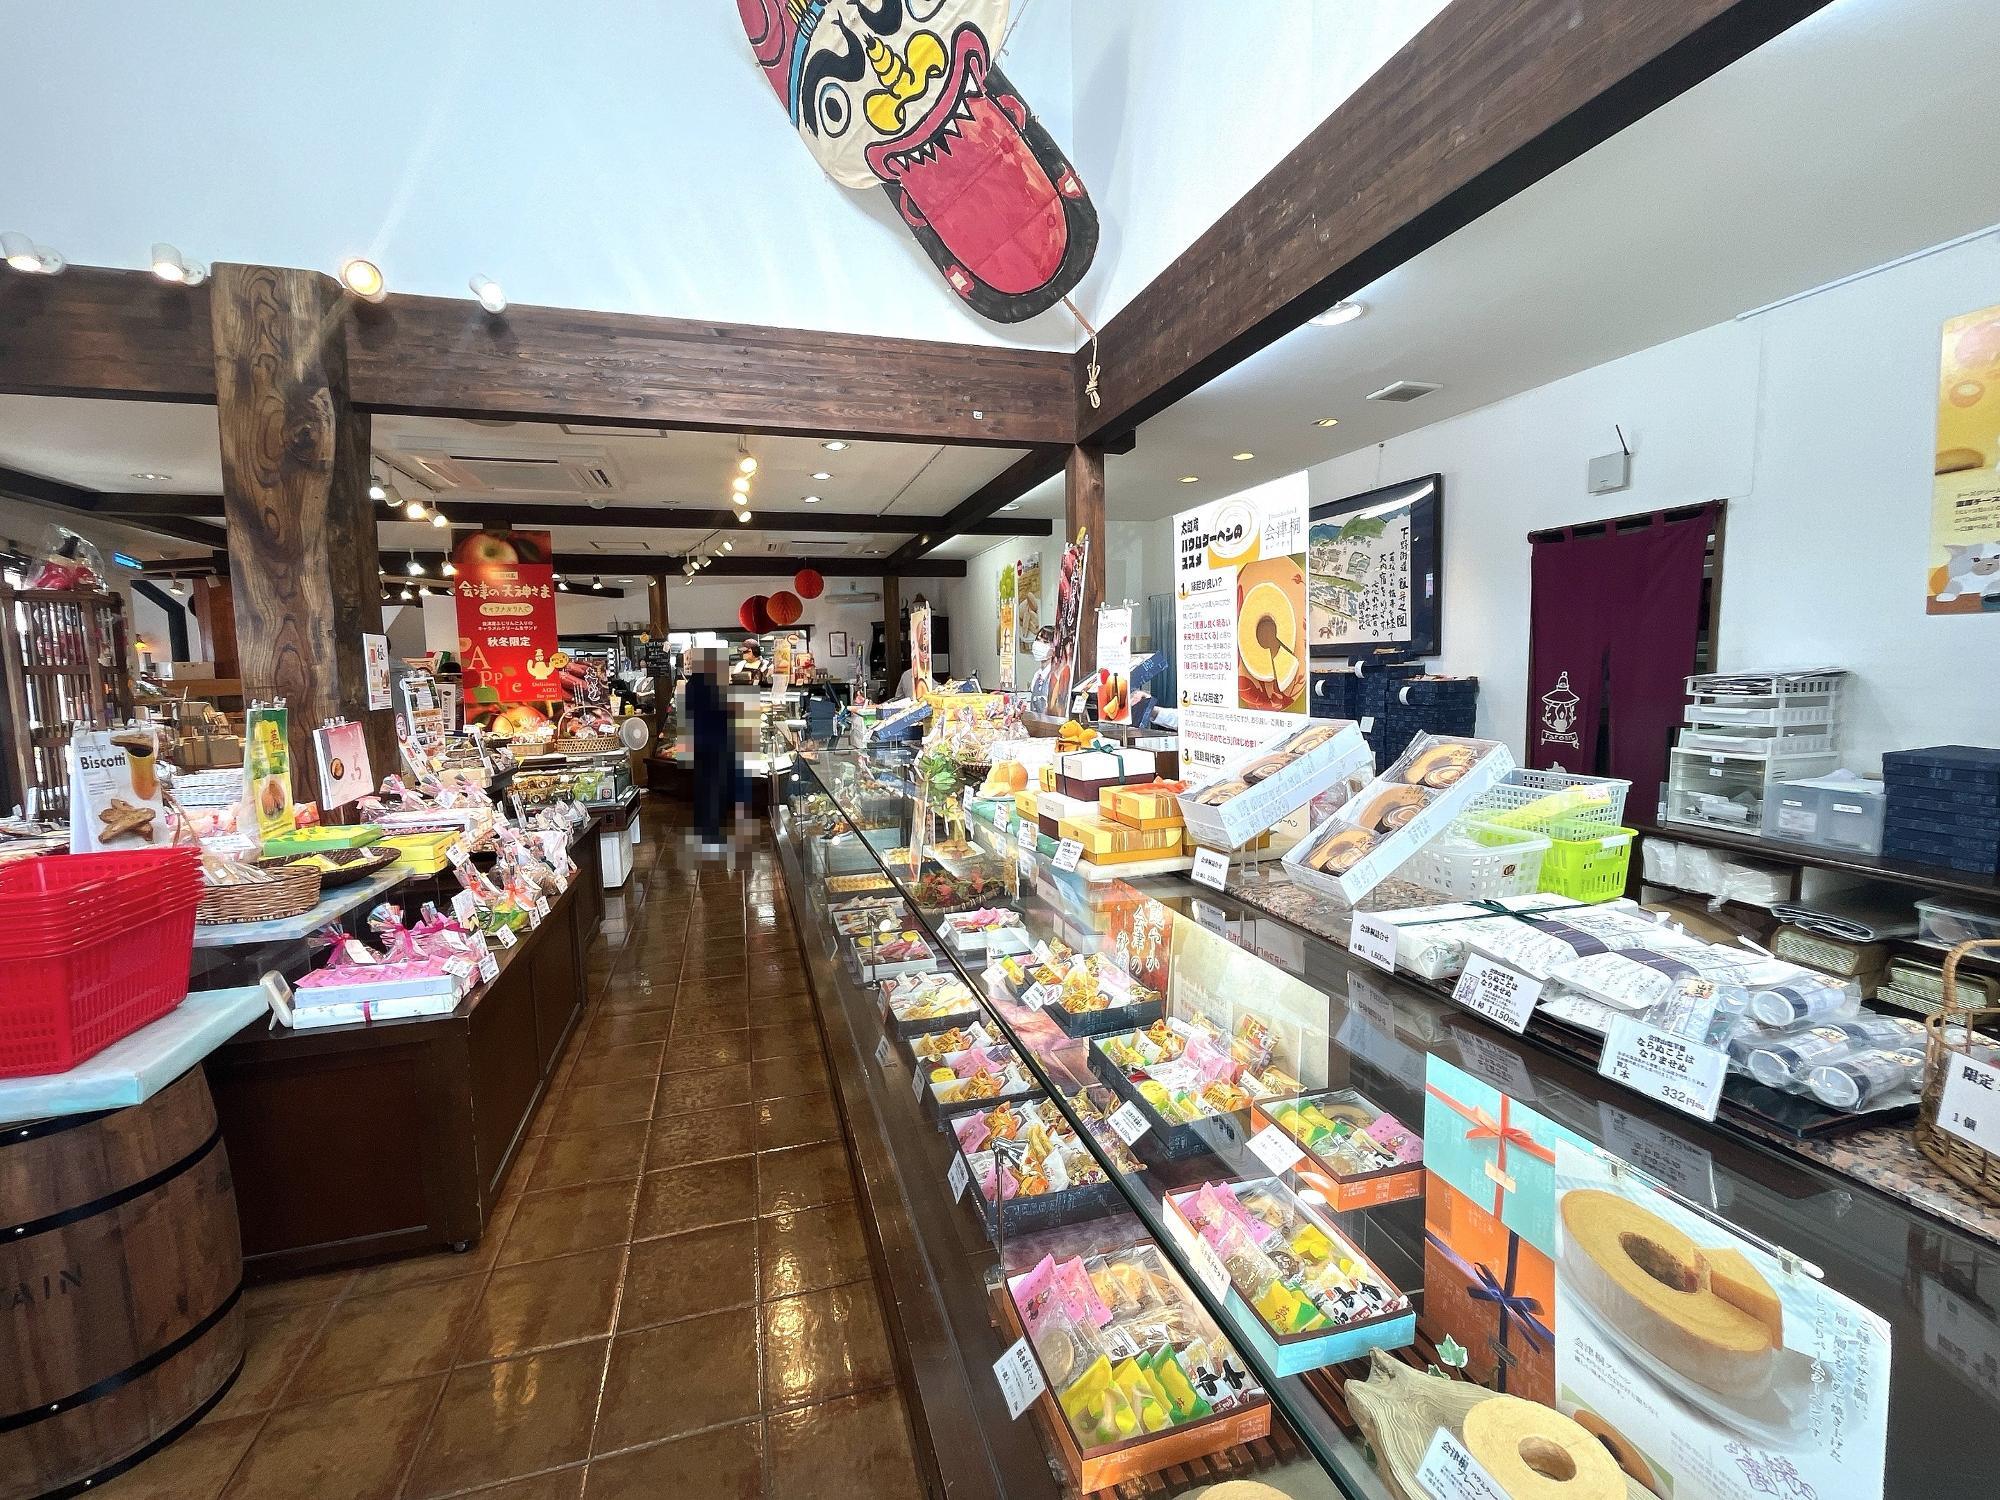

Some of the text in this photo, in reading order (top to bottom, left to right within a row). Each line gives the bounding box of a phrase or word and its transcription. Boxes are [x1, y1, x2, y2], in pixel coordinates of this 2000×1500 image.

[1181, 553, 1202, 570] ススメ
[459, 581, 551, 600] 会津の天神さま
[487, 636, 531, 647] 秋冬限定
[80, 752, 125, 770] Biscotti
[1481, 970, 1518, 991] ならぬことは
[1481, 979, 1512, 998] なりませぬ
[1637, 1037, 1696, 1065] ならぬことは
[1640, 1048, 1688, 1073] なりませぬ
[1962, 1065, 1995, 1090] 限定
